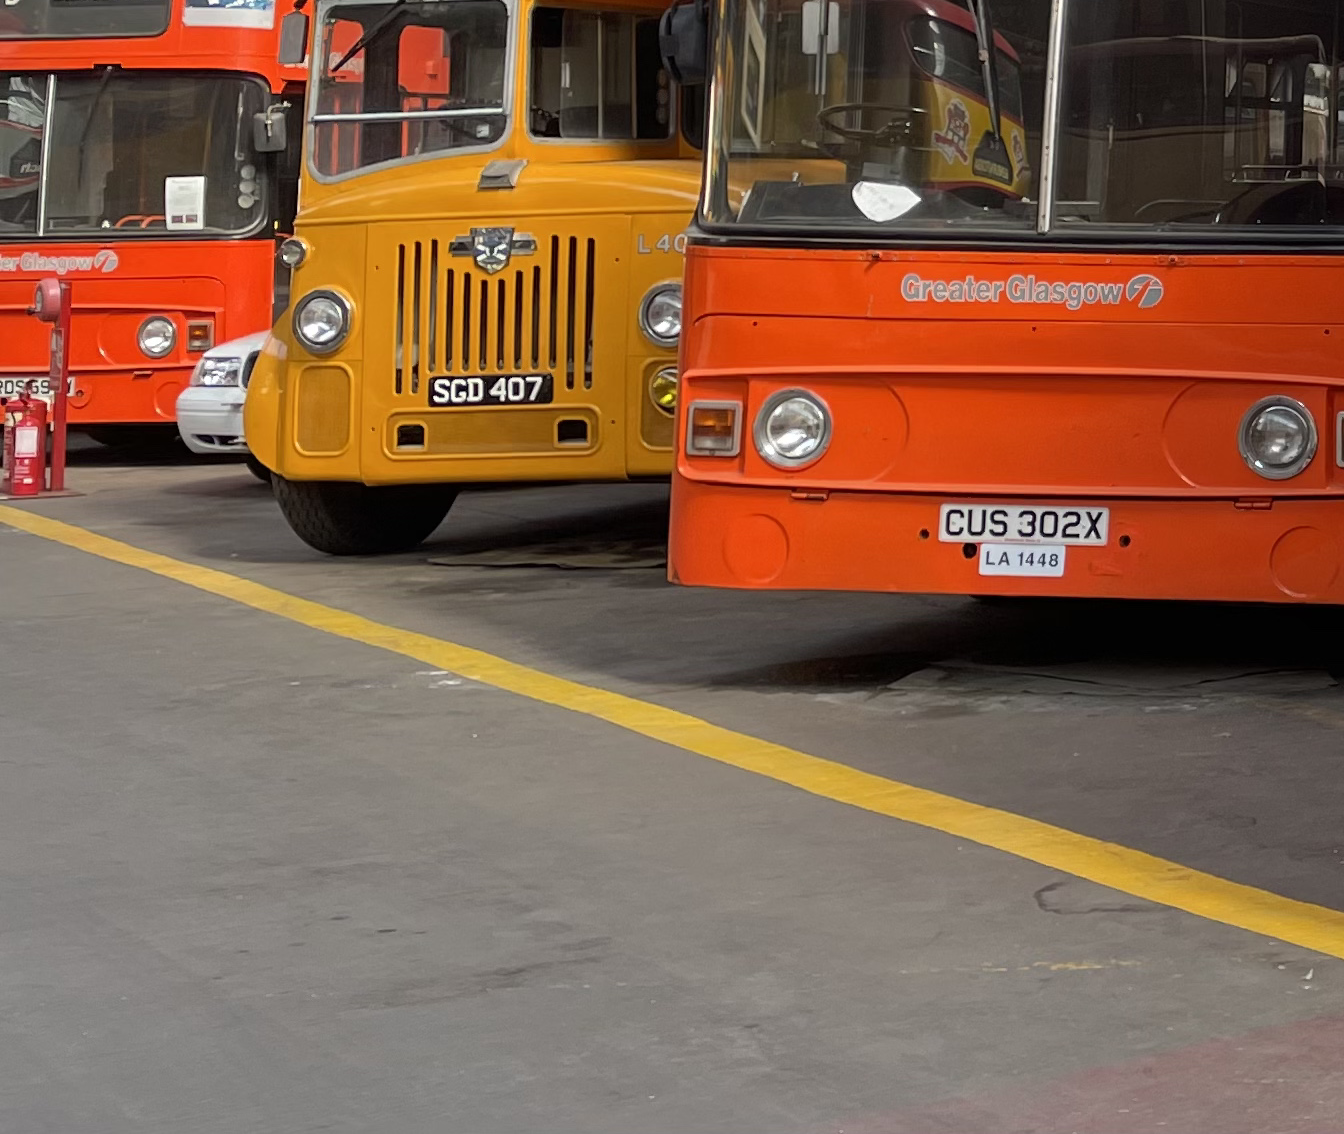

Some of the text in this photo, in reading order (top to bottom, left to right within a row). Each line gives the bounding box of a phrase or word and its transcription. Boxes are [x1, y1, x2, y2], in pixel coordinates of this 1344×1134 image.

[21, 252, 94, 275] Glasgow
[901, 273, 1124, 310] Greater Glasgow
[432, 377, 543, 403] SGD 407
[945, 509, 1103, 539] CUS 302X
[985, 551, 1059, 568] LA 1448
